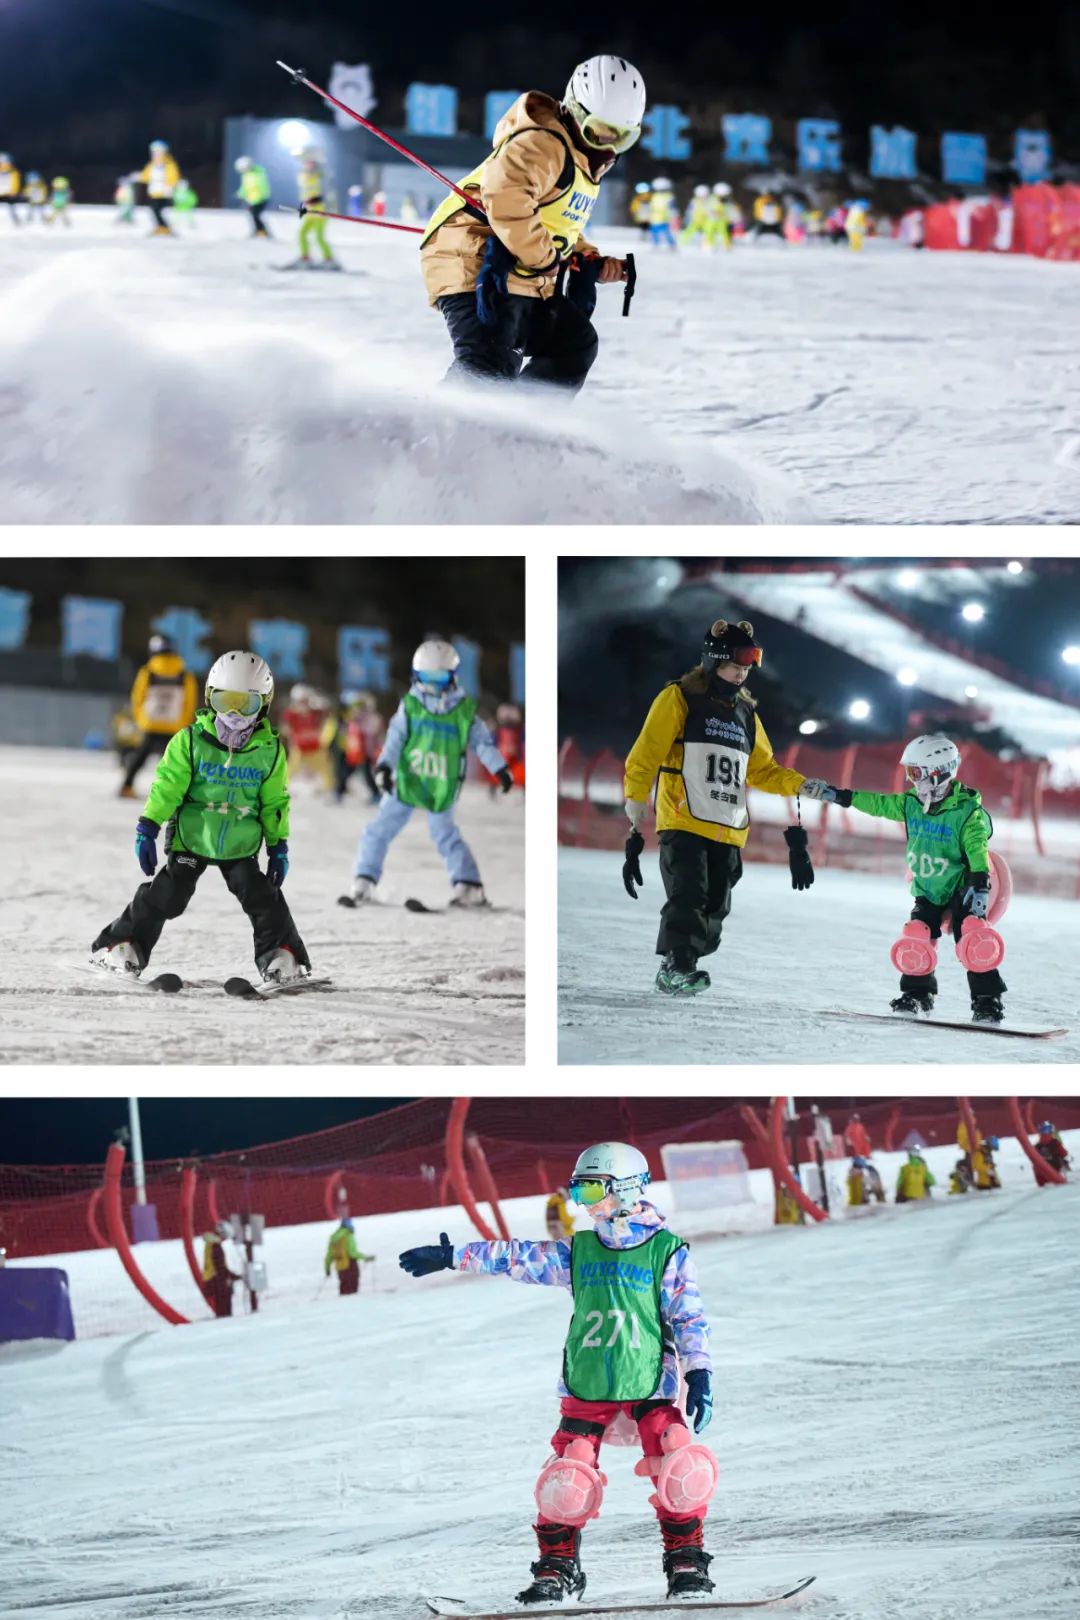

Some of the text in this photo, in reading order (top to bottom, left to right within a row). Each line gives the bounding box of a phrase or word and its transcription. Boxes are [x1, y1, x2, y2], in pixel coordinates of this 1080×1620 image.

[409, 748, 447, 783] 201
[906, 851, 950, 878] 207
[580, 1260, 654, 1285] YUYOUNG
[581, 1309, 642, 1349] 271
